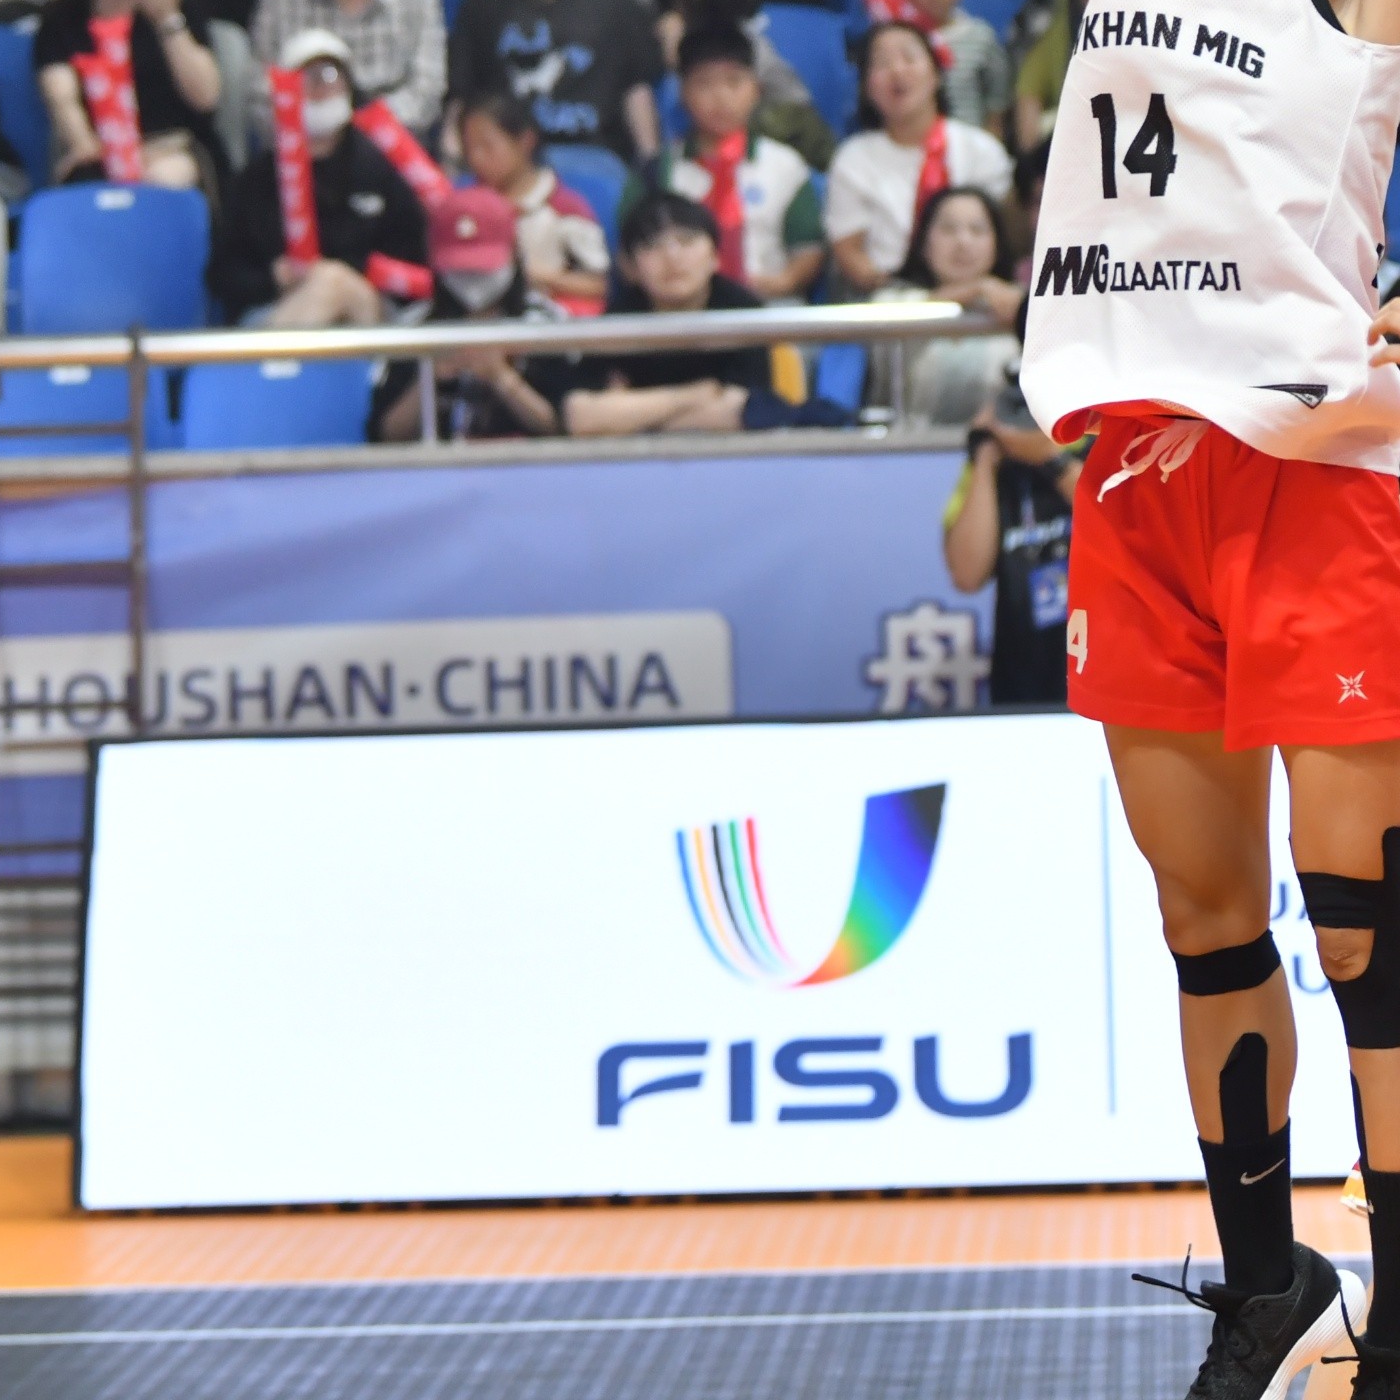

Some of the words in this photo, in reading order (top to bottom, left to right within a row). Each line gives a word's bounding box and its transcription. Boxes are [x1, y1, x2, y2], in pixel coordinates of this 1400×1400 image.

[1073, 10, 1182, 56] KHAN
[1192, 24, 1267, 79] MIG
[1090, 93, 1178, 199] 14
[1110, 260, 1242, 293] ДААТГАЛ
[597, 1032, 1033, 1127] FISU
